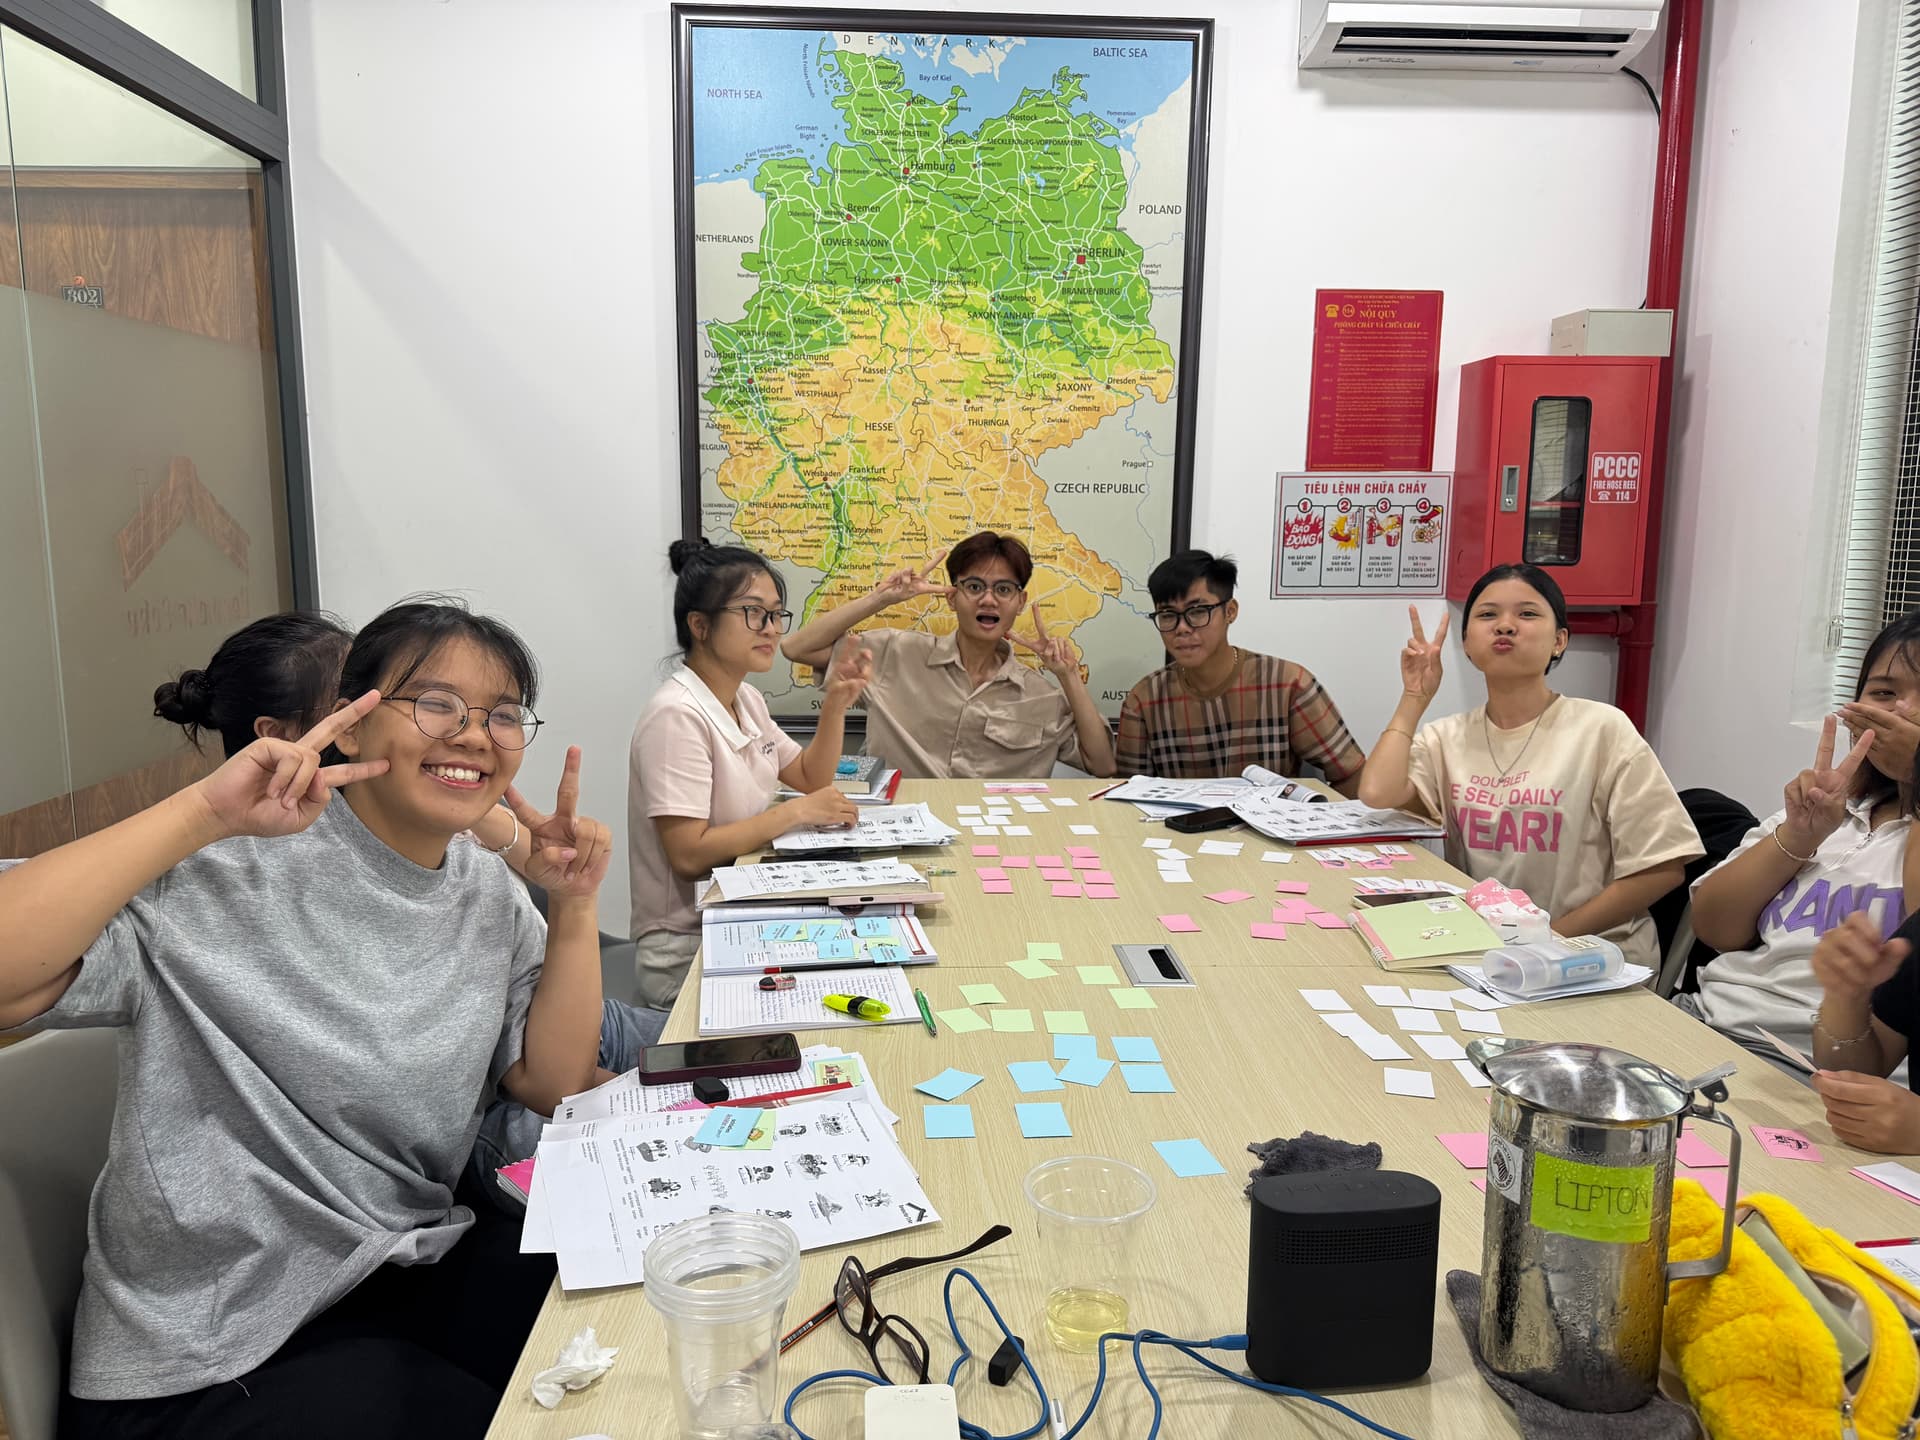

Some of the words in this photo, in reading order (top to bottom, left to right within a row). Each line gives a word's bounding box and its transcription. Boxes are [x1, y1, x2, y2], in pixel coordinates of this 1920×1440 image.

[843, 34, 996, 49] DENMARK
[1093, 47, 1125, 57] BALTIC
[1128, 48, 1148, 58] SEA
[919, 74, 931, 82] Bay
[707, 88, 741, 98] NORTH
[744, 89, 763, 99] SEA
[912, 97, 926, 105] Kiel
[911, 161, 955, 173] Hamburg
[847, 204, 880, 212] Bremen
[1138, 205, 1182, 215] POLAND
[695, 234, 754, 243] NETHERLANDS
[822, 239, 852, 247] LOWER
[855, 239, 889, 247] SAXONY
[1089, 248, 1126, 257] BERLIN
[67, 289, 98, 303] 302
[1377, 310, 1397, 320] QUY
[788, 352, 829, 360] Dortmund
[863, 366, 887, 374] Kassel
[1032, 372, 1057, 380] Leipzig
[1056, 383, 1093, 391] SAXONY
[864, 422, 894, 431] HESSE
[1122, 460, 1146, 469] Prague
[1593, 456, 1639, 478] PCCC
[849, 465, 886, 474] Frankfurt
[1054, 483, 1089, 493] CZECH
[1093, 483, 1146, 494] REPUBLIC
[1304, 481, 1328, 494] TIÊU
[1333, 480, 1360, 496] LỆNH
[1365, 480, 1395, 494] CHỮA
[1398, 480, 1427, 494] CHÁY
[1593, 480, 1606, 490] FIRE
[1606, 480, 1622, 490] HOSE
[1622, 480, 1636, 490] REEL
[1616, 491, 1630, 501] 114
[1301, 501, 1308, 510] 1
[1340, 500, 1349, 510] 2
[1380, 501, 1388, 510] 3
[1419, 501, 1427, 510] 4
[840, 584, 874, 593] Stuttgart
[1102, 691, 1131, 700] AUST
[1470, 771, 1530, 788] DOUBLET
[1451, 783, 1461, 800] E
[1464, 787, 1504, 808] SELL
[1508, 789, 1564, 806] DAILY
[1554, 1178, 1650, 1215] LIPTON
